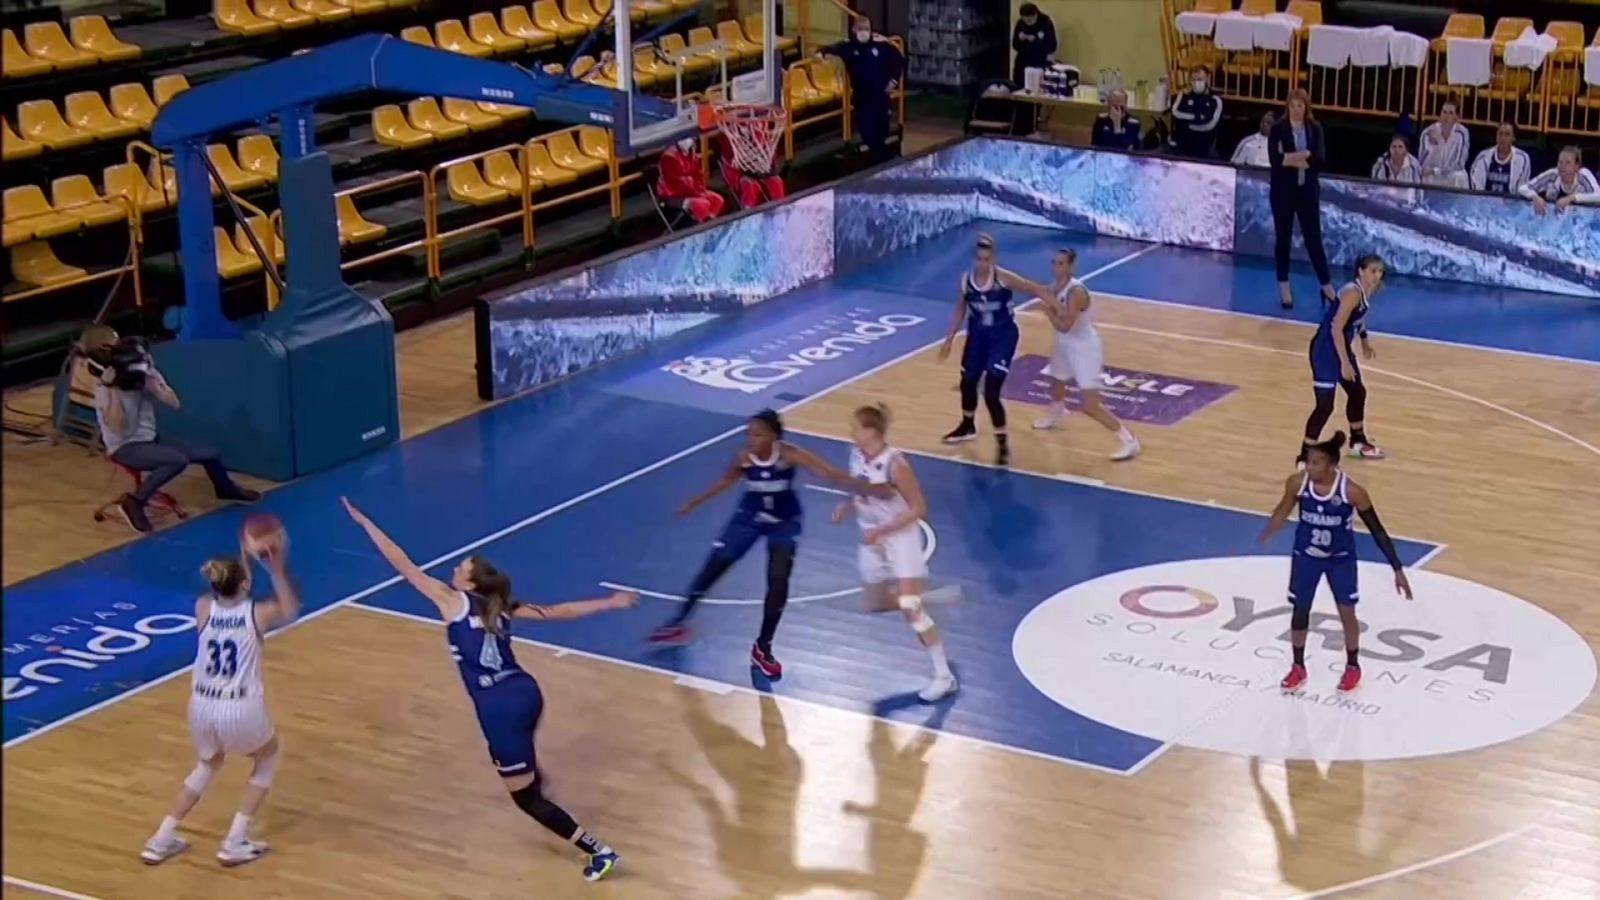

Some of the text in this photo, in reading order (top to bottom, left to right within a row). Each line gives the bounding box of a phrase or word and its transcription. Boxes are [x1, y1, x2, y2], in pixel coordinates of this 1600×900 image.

[1311, 528, 1332, 547] 20
[206, 639, 238, 679] 33
[1086, 613, 1496, 703] SOLUCONES
[1102, 652, 1251, 689] SALAMANCA
